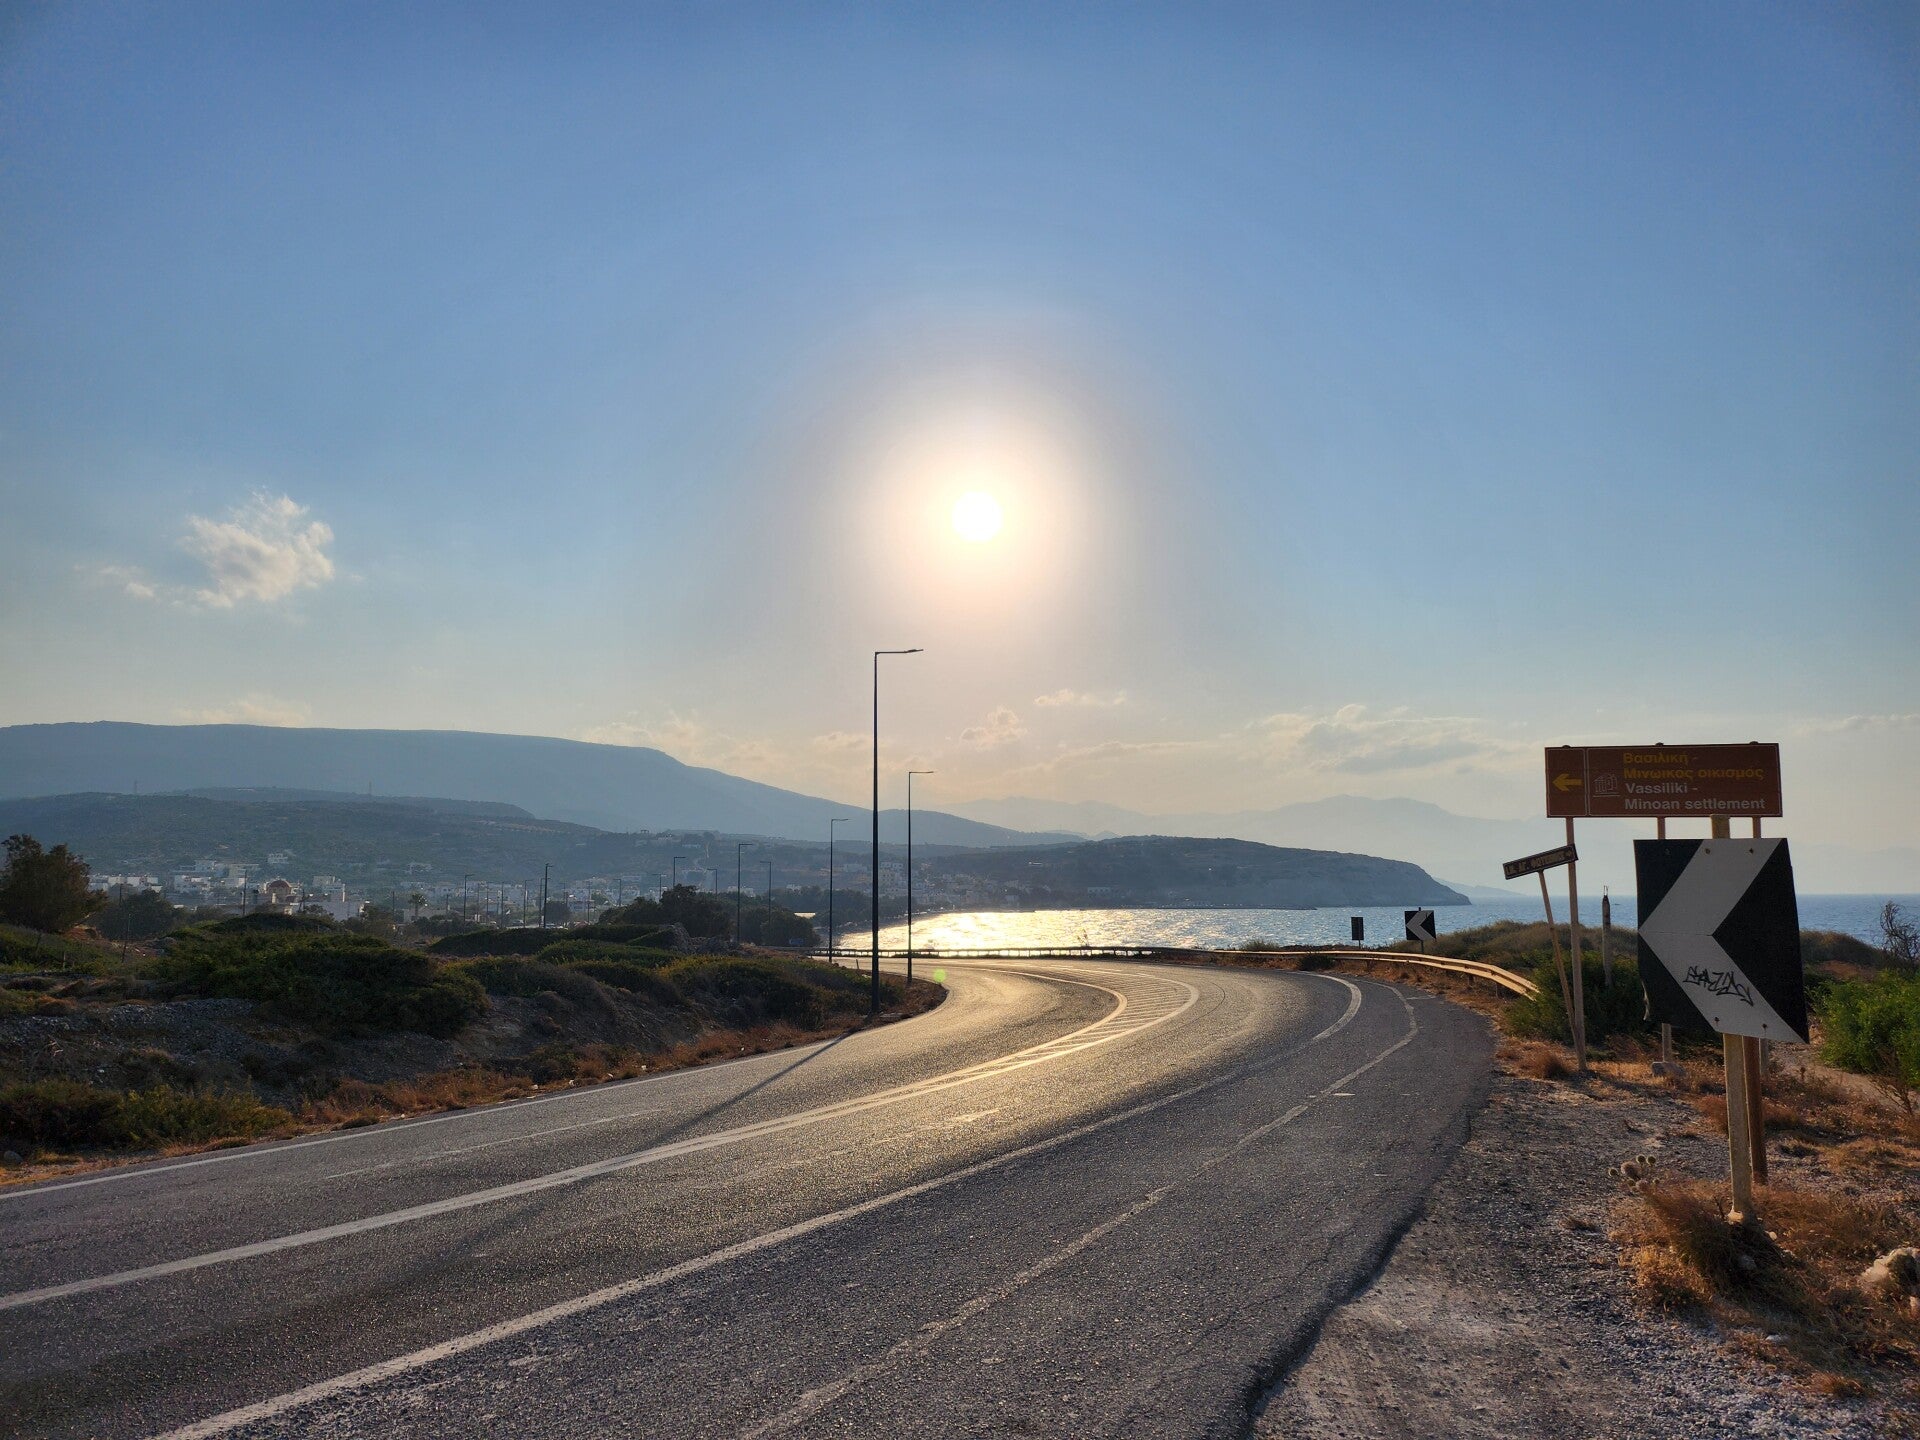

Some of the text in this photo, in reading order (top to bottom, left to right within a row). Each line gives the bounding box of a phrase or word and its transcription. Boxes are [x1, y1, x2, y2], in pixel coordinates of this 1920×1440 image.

[1624, 752, 1688, 766] Βασιλική
[1698, 767, 1764, 780] οικισμός
[1625, 782, 1688, 794] Vassiliki
[1625, 797, 1765, 810] Minoan settlement
